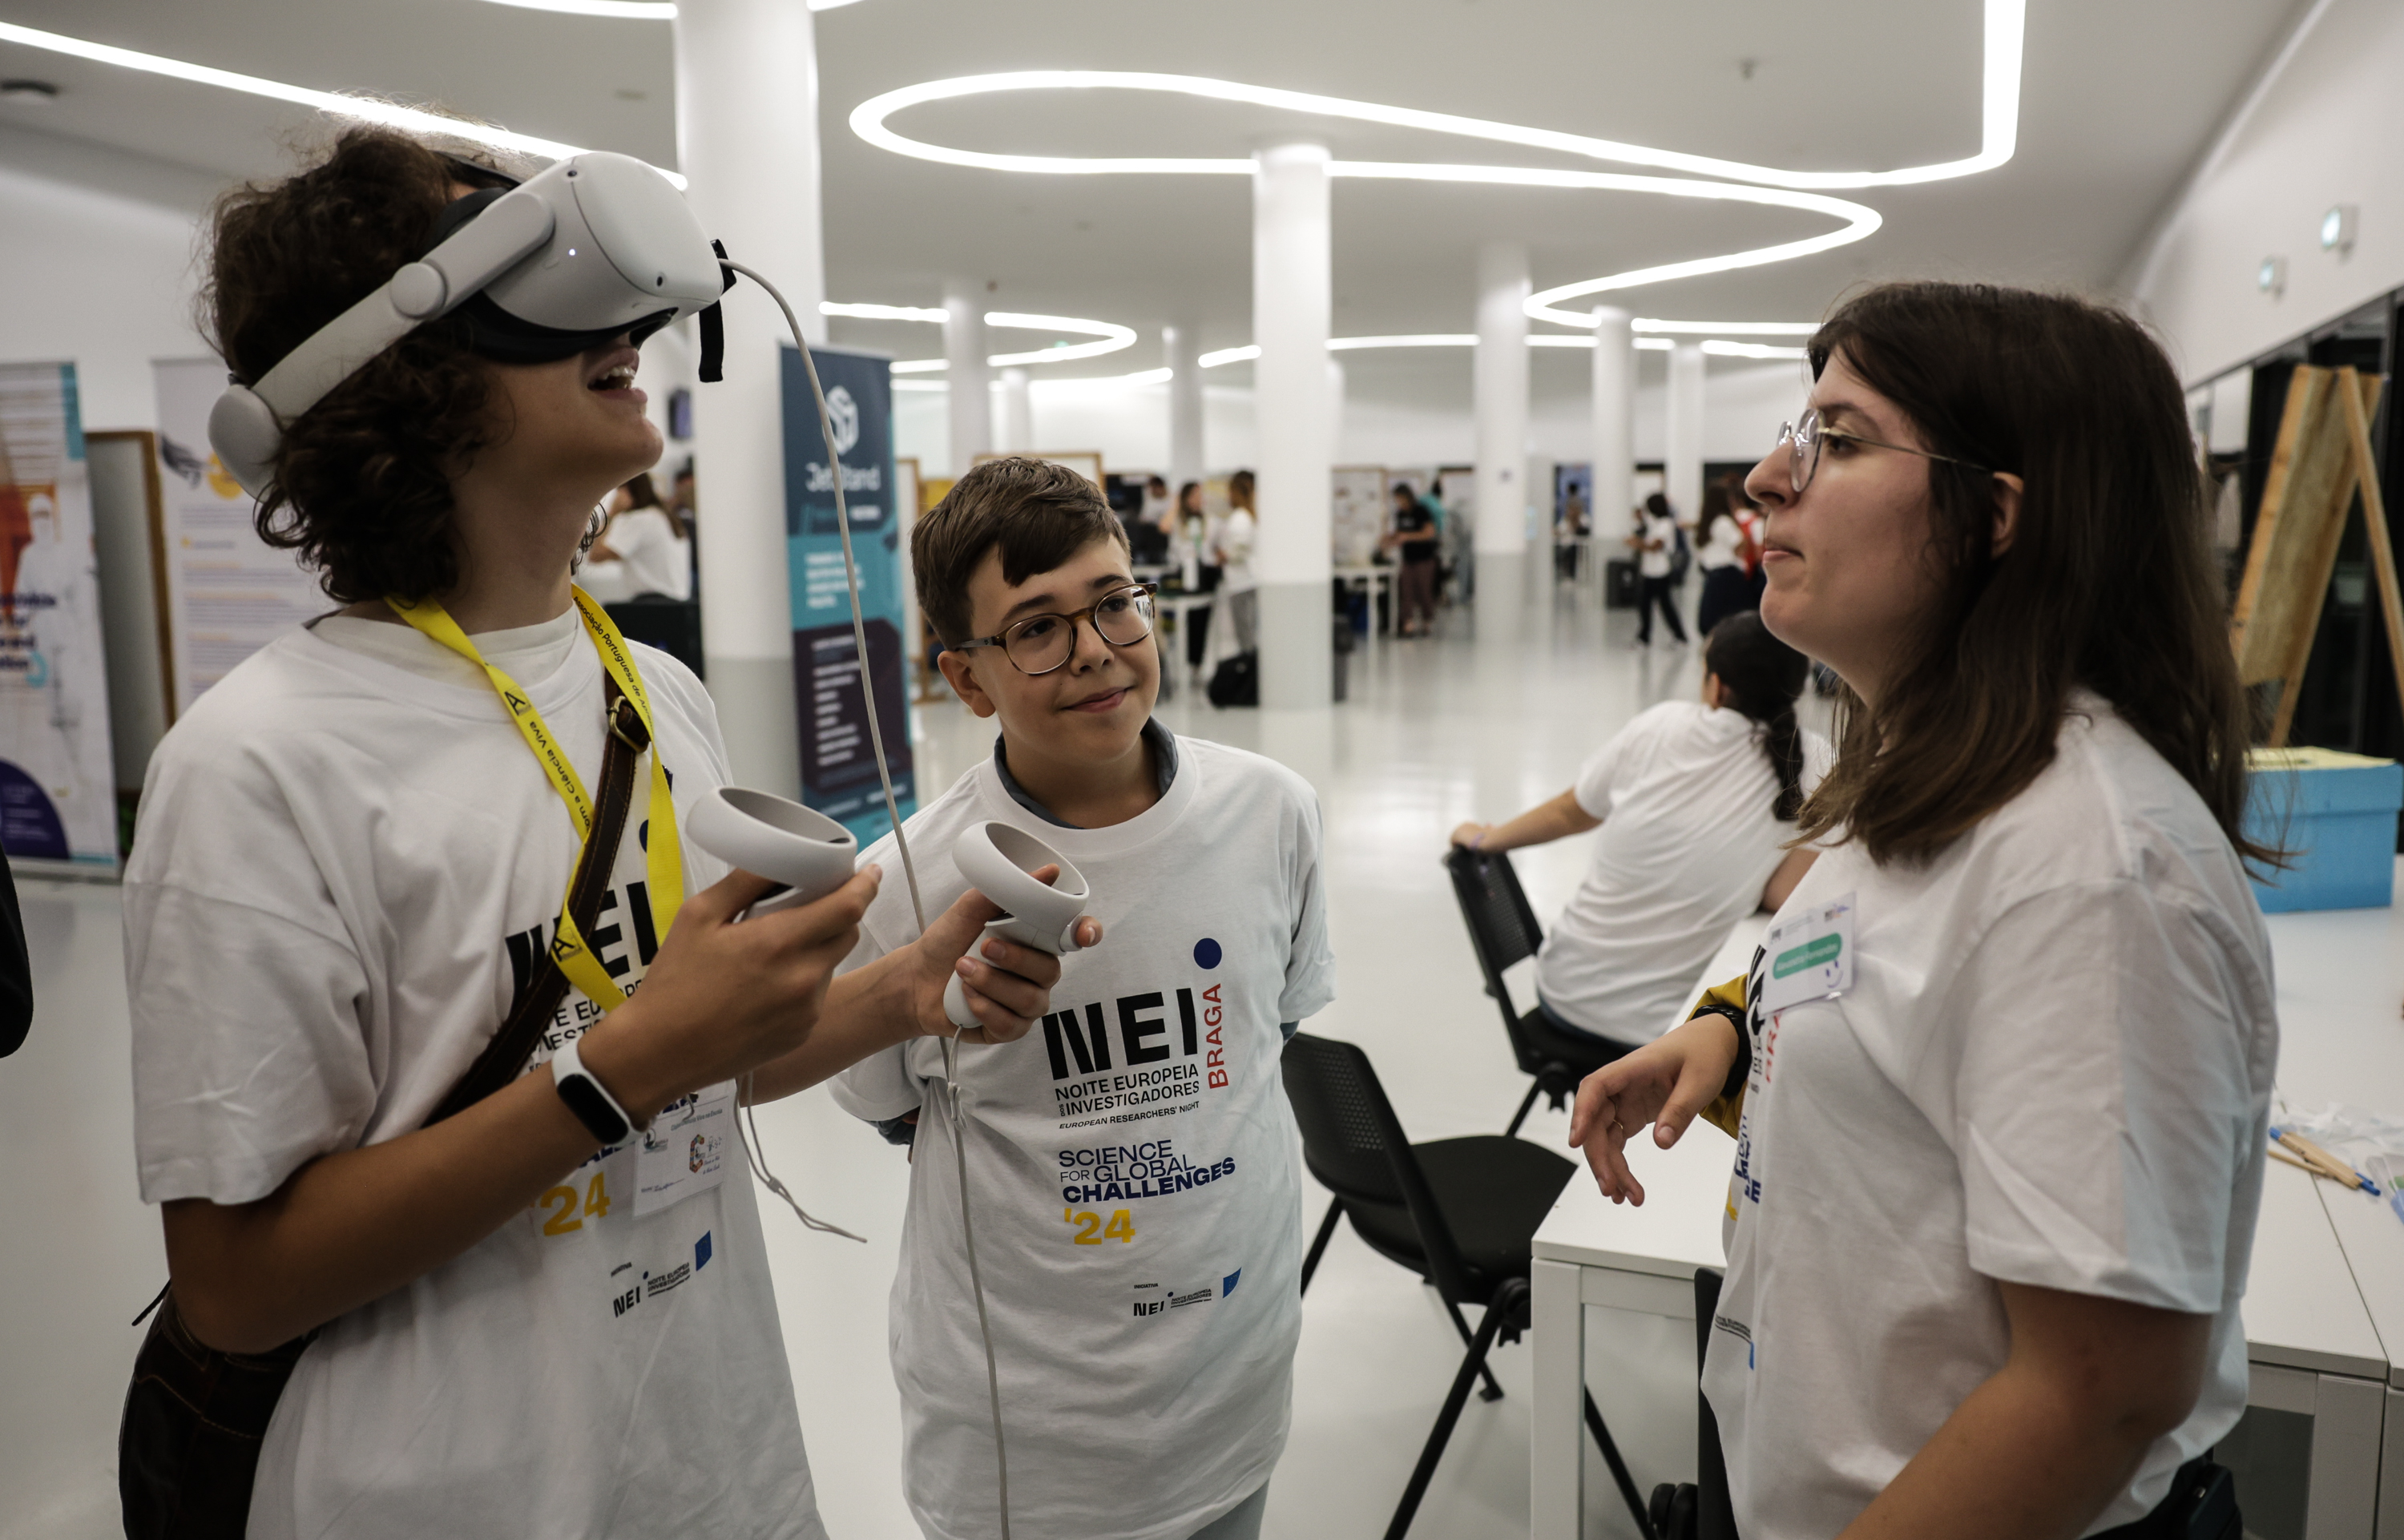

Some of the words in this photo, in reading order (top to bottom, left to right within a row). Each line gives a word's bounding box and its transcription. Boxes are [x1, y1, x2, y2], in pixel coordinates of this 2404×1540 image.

[572, 596, 604, 635] Associação
[603, 633, 634, 683] Portuguesa
[631, 684, 641, 696] de
[529, 721, 547, 748] Viva
[547, 749, 575, 794] Ciência
[574, 796, 581, 804] a
[1042, 988, 1197, 1081] NEI
[1202, 983, 1229, 1089] BRAGA
[1055, 1078, 1111, 1102] NOITE
[1113, 1063, 1199, 1091] EUROPEIA
[1066, 1081, 1200, 1115] INVESTIGADORES
[1059, 1118, 1107, 1129] EUROPEAN
[1110, 1107, 1177, 1124] RESEARCHERS'
[1179, 1101, 1200, 1113] NIGHT
[1059, 1139, 1173, 1167] SCIENCE
[1060, 1170, 1090, 1183] FOR
[1093, 1155, 1196, 1183] GLOBAL
[1063, 1157, 1236, 1203] CHALLENGES
[1064, 1208, 1135, 1245] '24
[613, 1286, 640, 1318] NEI
[1133, 1300, 1164, 1316] NEI
